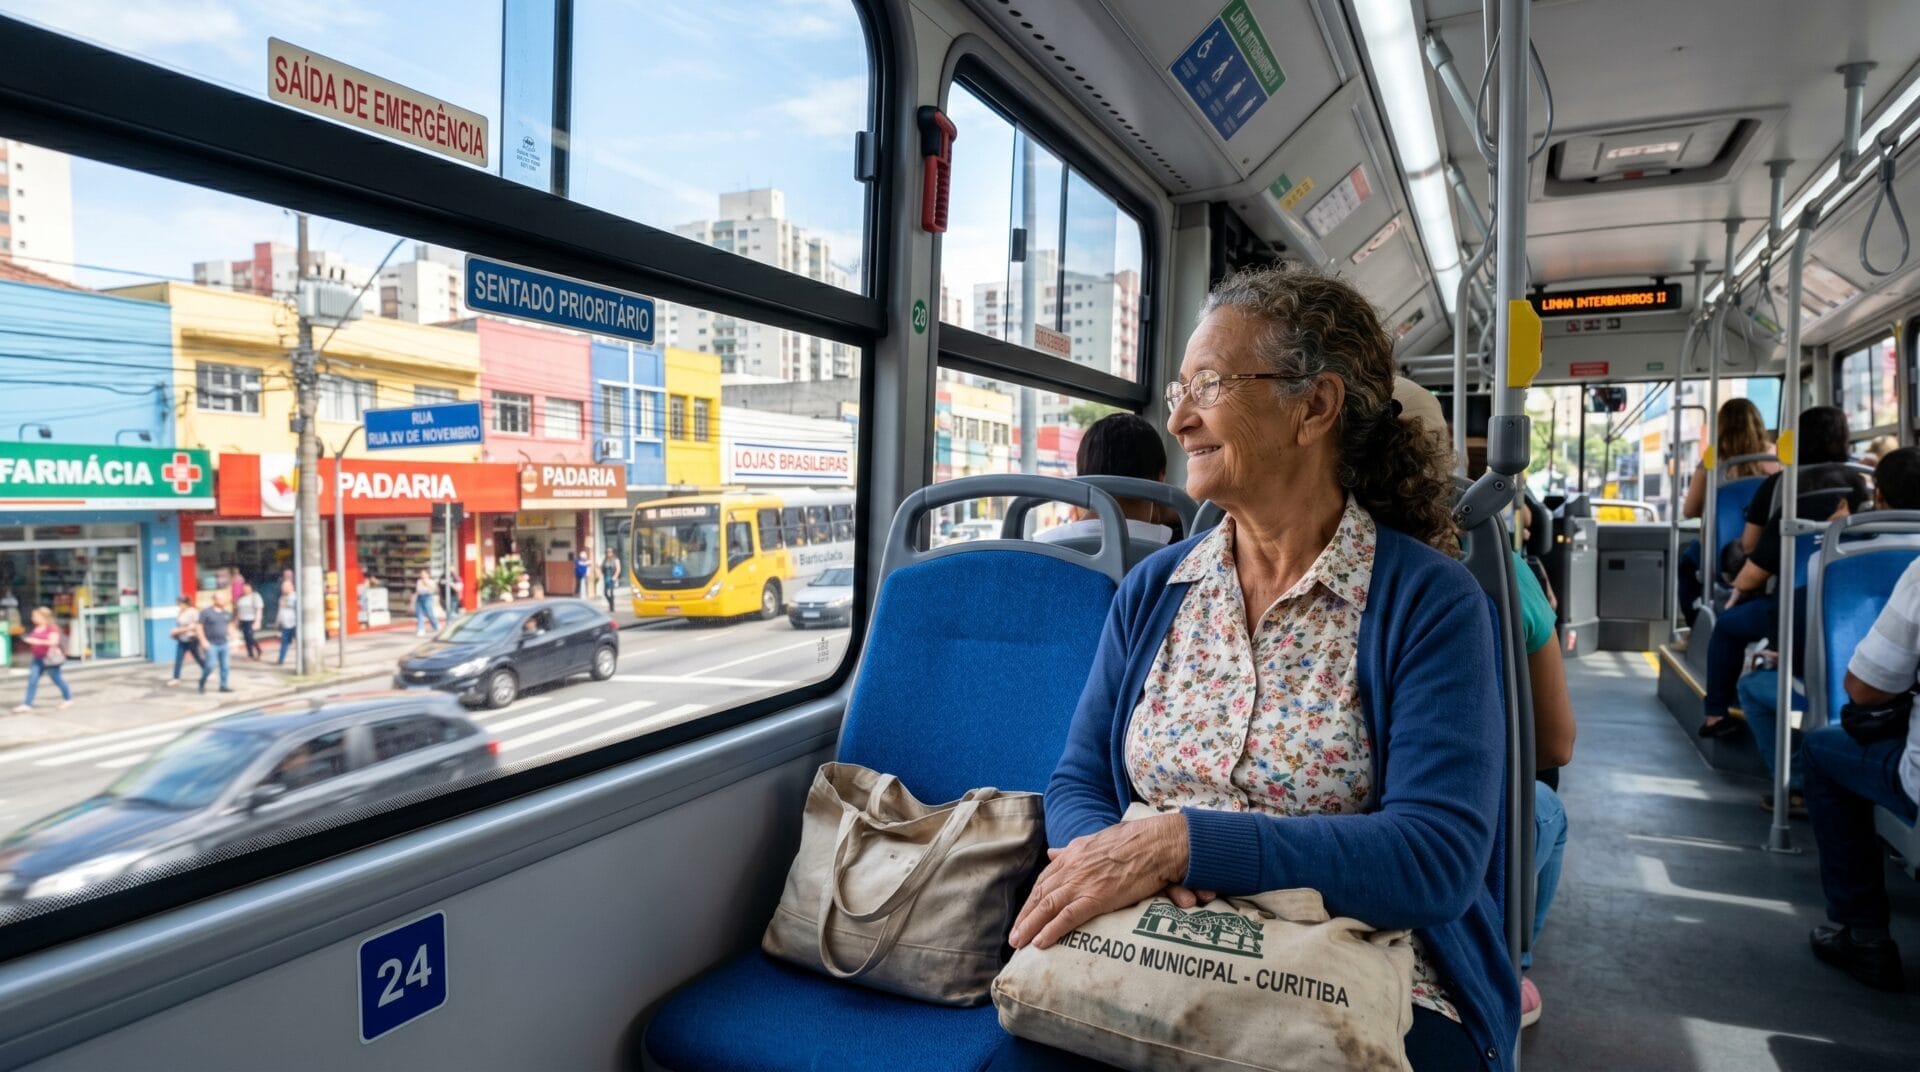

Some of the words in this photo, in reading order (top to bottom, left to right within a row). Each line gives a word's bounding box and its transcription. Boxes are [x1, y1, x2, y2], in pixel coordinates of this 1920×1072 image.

[274, 55, 338, 110] SAÍDA
[343, 78, 368, 120] DE
[374, 89, 485, 159] EMERGÊNCIA
[474, 270, 555, 313] SENTADO
[559, 288, 650, 333] PRIORITÁRIO
[1542, 299, 1574, 311] LINHA
[1576, 293, 1654, 308] INTERBAIRROS
[1656, 292, 1667, 303] II
[411, 410, 434, 425] RUA
[368, 432, 389, 445] RUA
[390, 430, 404, 444] XV
[406, 429, 420, 443] DE
[422, 425, 480, 442] NOVEMBRO
[0, 454, 154, 486] FARMÁCIA
[735, 451, 776, 469] LOJAS
[779, 454, 849, 472] BRASILEIRAS
[339, 472, 457, 499] PADARIA
[542, 466, 617, 487] PADARIA
[377, 943, 432, 1008] 24
[1139, 946, 1238, 985] MUNICIPAL
[1256, 968, 1350, 1008] CURITIBA
